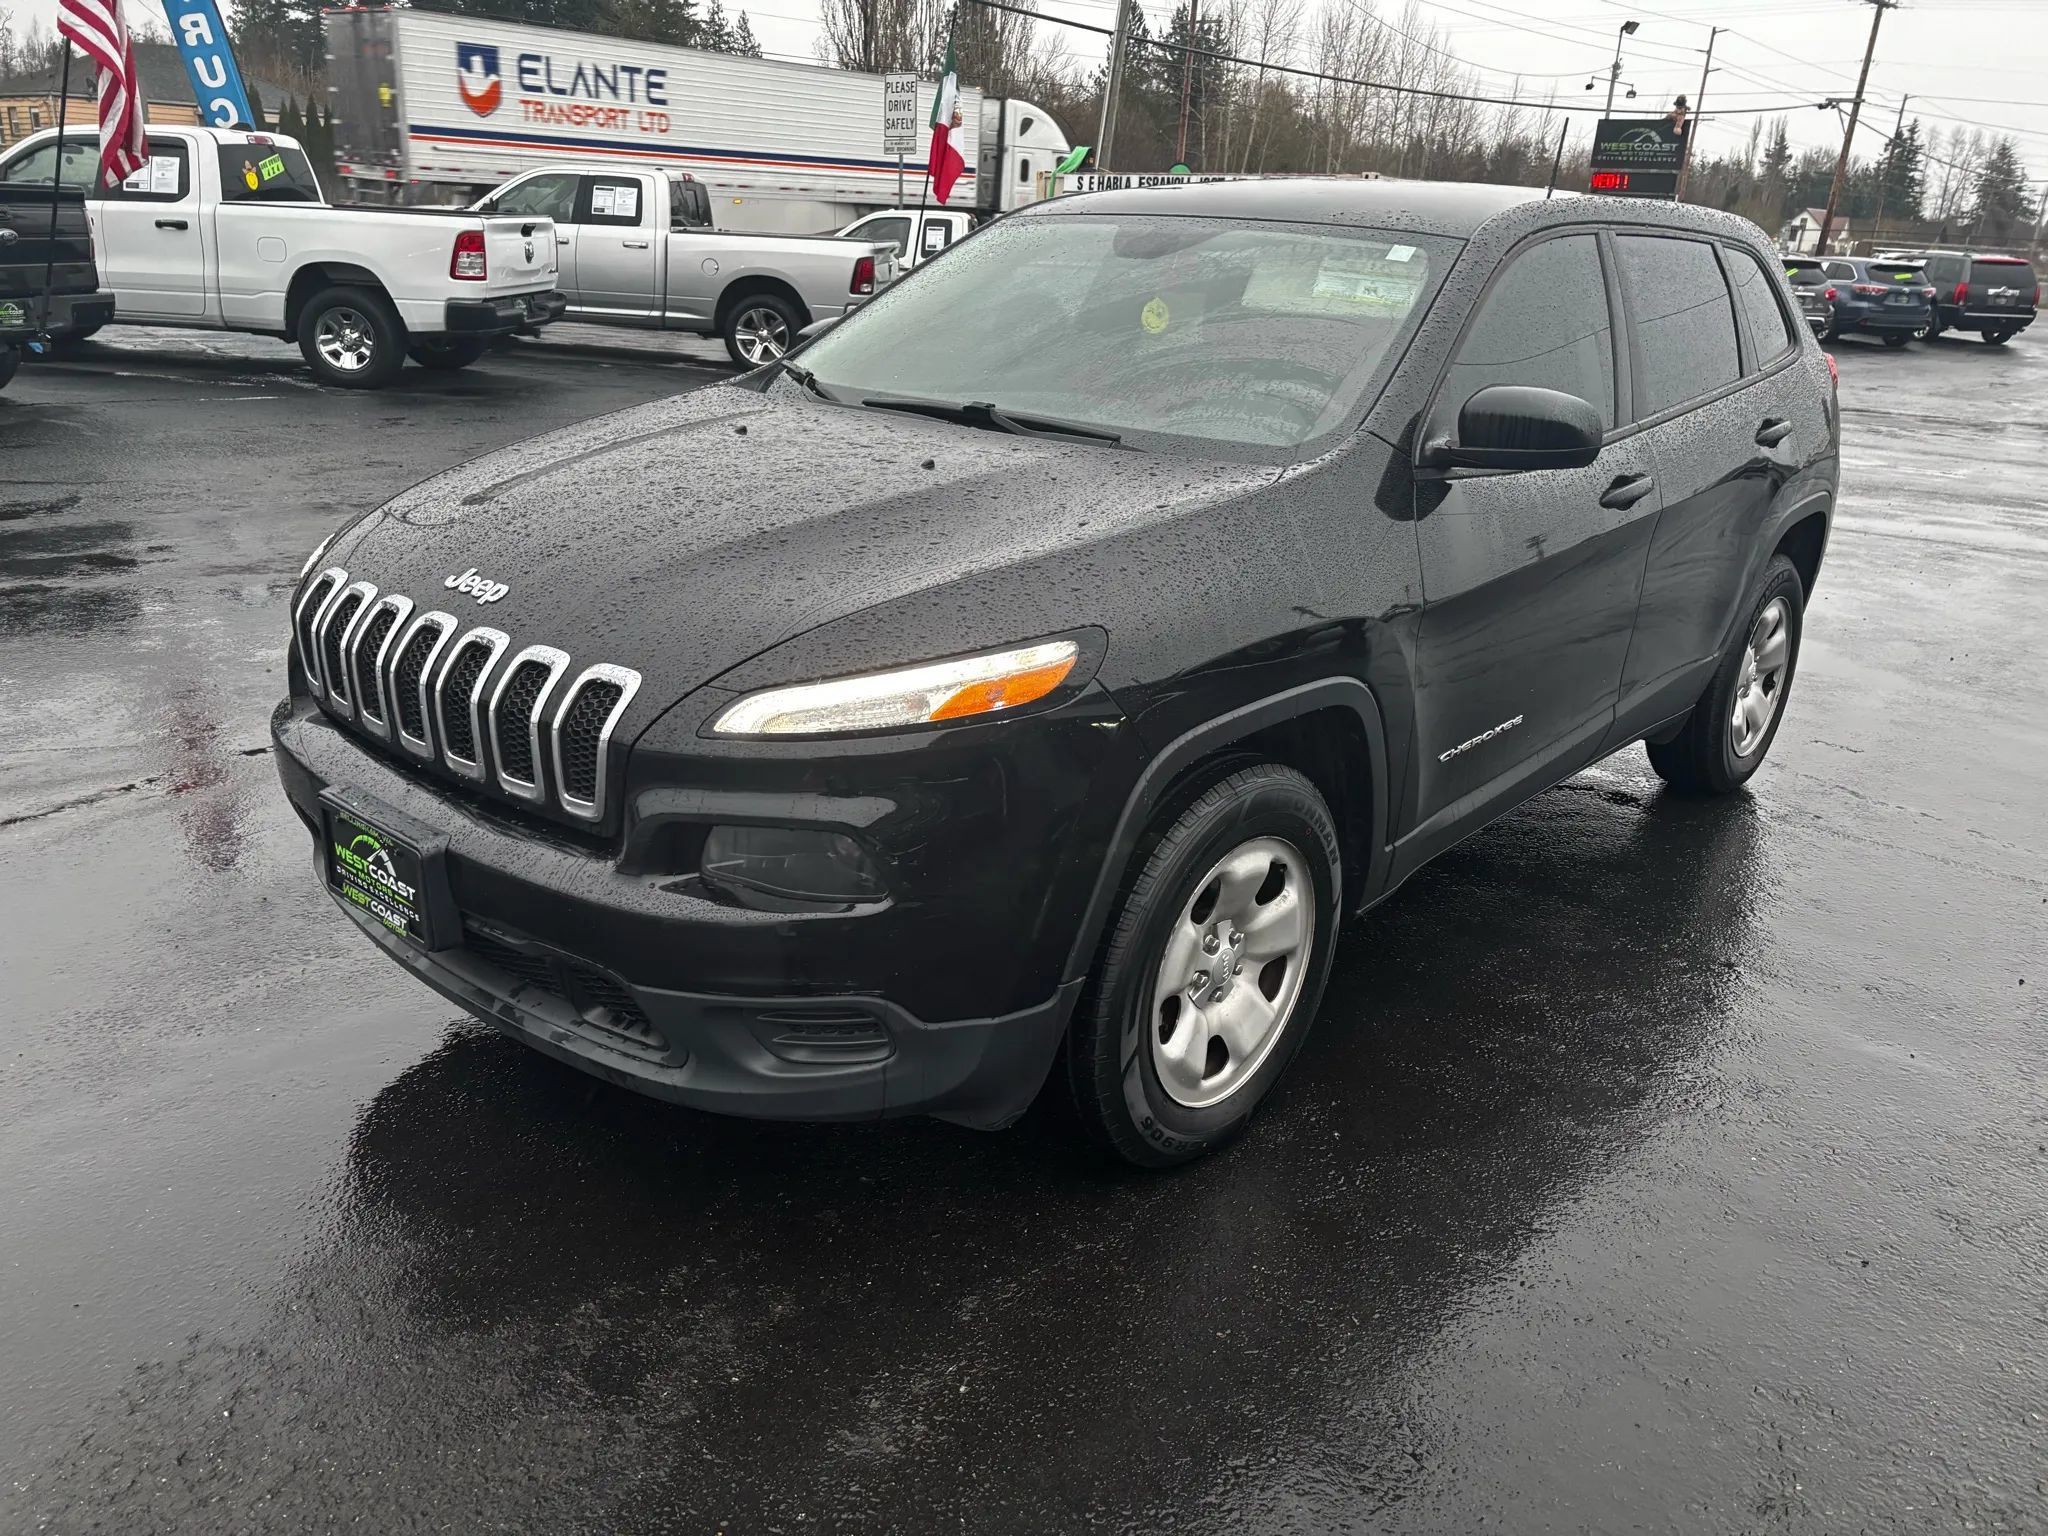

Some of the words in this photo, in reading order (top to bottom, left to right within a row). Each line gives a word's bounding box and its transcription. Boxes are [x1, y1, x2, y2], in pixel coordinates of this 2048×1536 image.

[518, 53, 669, 106] ELANTE
[886, 81, 916, 94] PLEASE
[518, 99, 630, 130] TRANSPORT
[638, 110, 671, 134] LTD
[888, 99, 912, 112] DRIVE
[886, 117, 915, 130] SAFELY
[1097, 175, 1131, 190] HABLA
[444, 567, 510, 605] Jeep
[1438, 714, 1524, 762] CHEROKEE
[334, 842, 416, 901] WESTCOAST
[358, 872, 393, 897] MOTORS
[336, 865, 369, 889] DRIVING
[369, 886, 420, 922] EXCELLENCE
[342, 882, 407, 930] WESTCOAST
[383, 918, 407, 937] MOTORS
